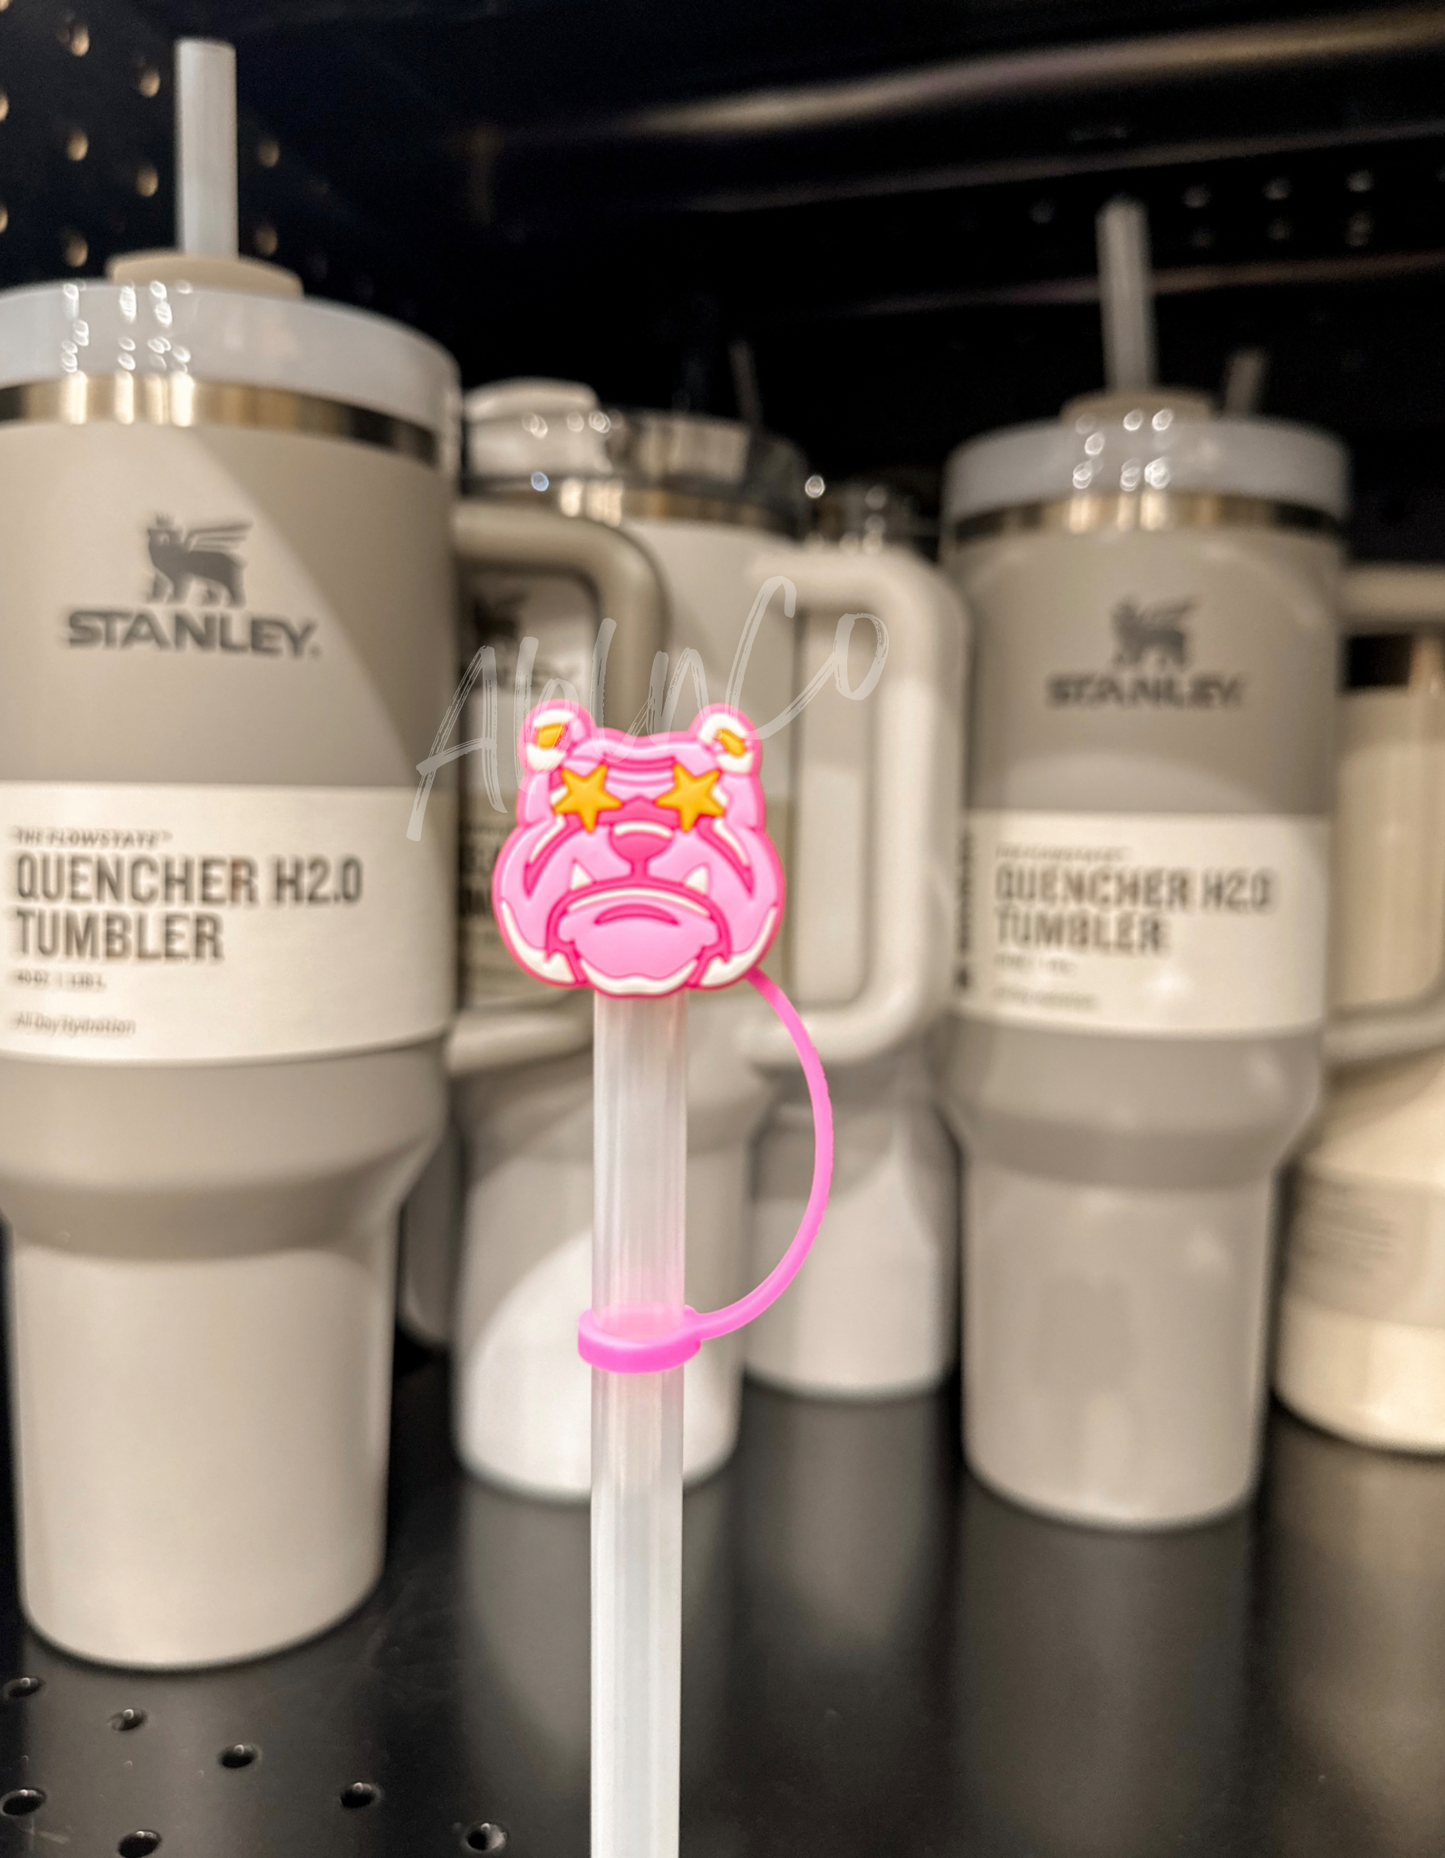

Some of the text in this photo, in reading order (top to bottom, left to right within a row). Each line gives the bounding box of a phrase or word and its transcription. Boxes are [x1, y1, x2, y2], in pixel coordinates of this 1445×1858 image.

[15, 854, 364, 905] QUENCHER H2.0
[996, 866, 1192, 911] QUENCHER
[15, 908, 225, 962] TUMBLER
[995, 906, 1166, 954] TUMBLER
